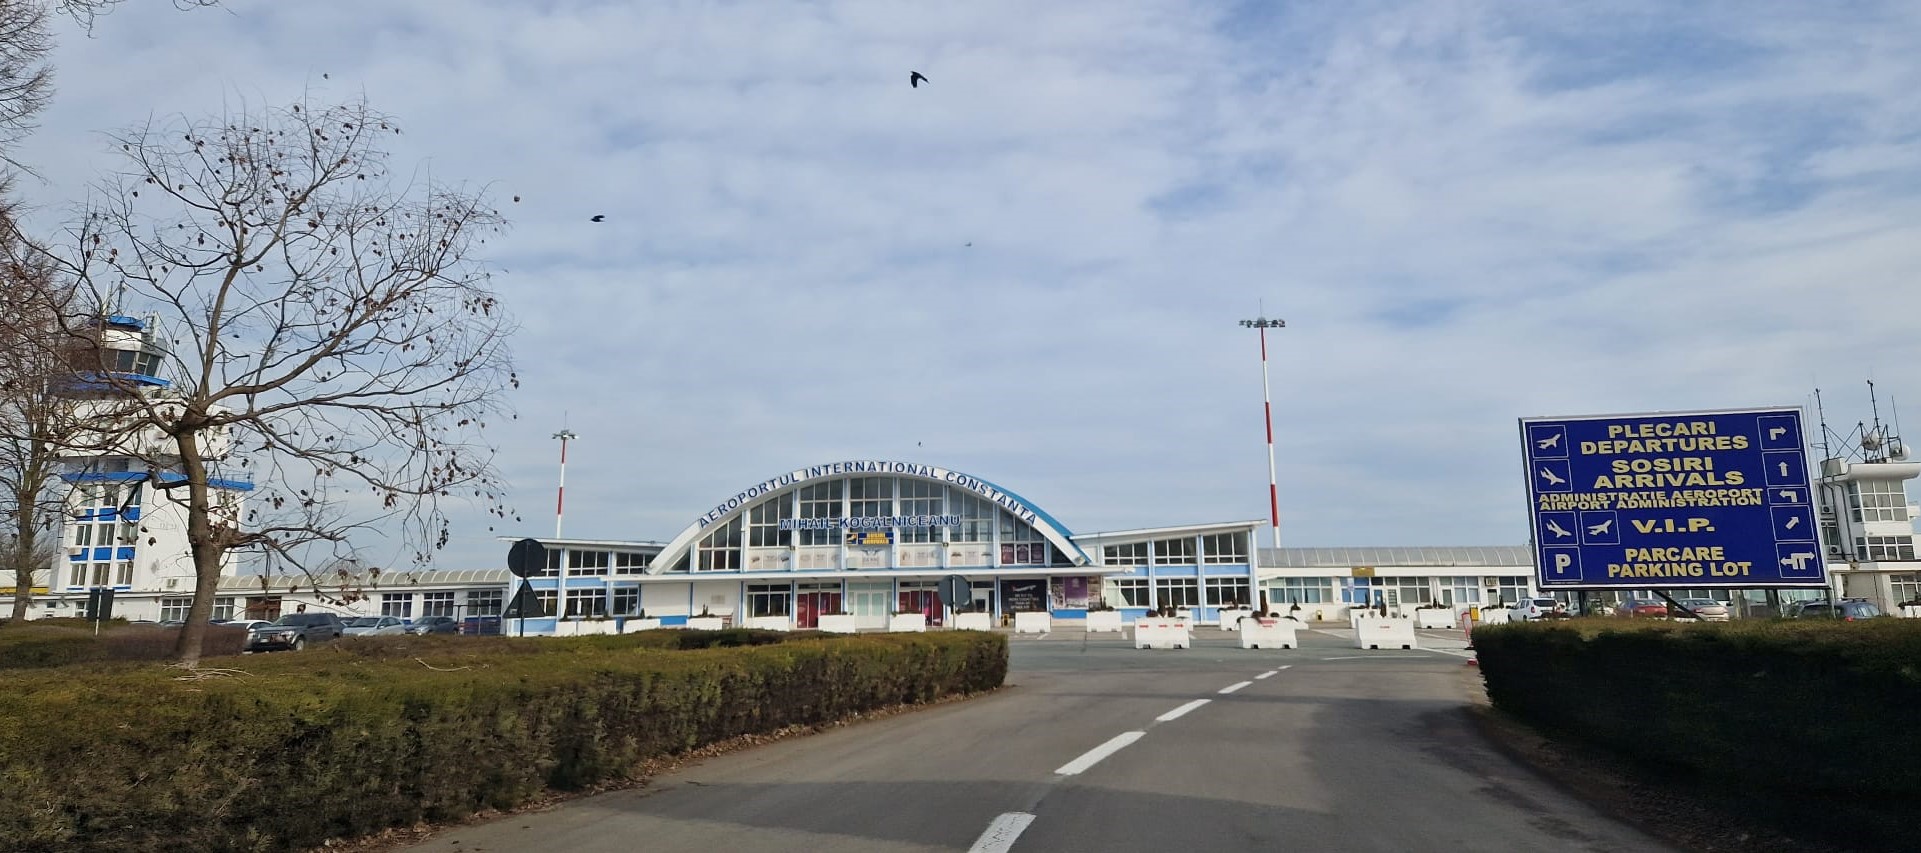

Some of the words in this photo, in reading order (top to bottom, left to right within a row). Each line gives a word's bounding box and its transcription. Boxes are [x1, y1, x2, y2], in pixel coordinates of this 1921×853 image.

[1608, 421, 1716, 439] PLECARI
[1581, 435, 1749, 455] DEPARTURES
[1612, 456, 1713, 474] SOSIRI
[1594, 470, 1745, 489] ARRIVALS
[699, 470, 799, 528] AEROPORTUL
[805, 460, 938, 478] INTERNATIONAL
[1539, 491, 1666, 503] ADMINISTRATIE
[1671, 488, 1764, 500] AEROPORT
[1540, 500, 1610, 511] AIRPORT
[1616, 496, 1762, 509] ADMINISTRATION
[779, 516, 835, 531] MIHAIL
[1631, 518, 1716, 534] V.I.P.
[1625, 547, 1725, 562] PARCARE
[1608, 562, 1704, 578] PARKING
[1710, 561, 1752, 577] LOT
